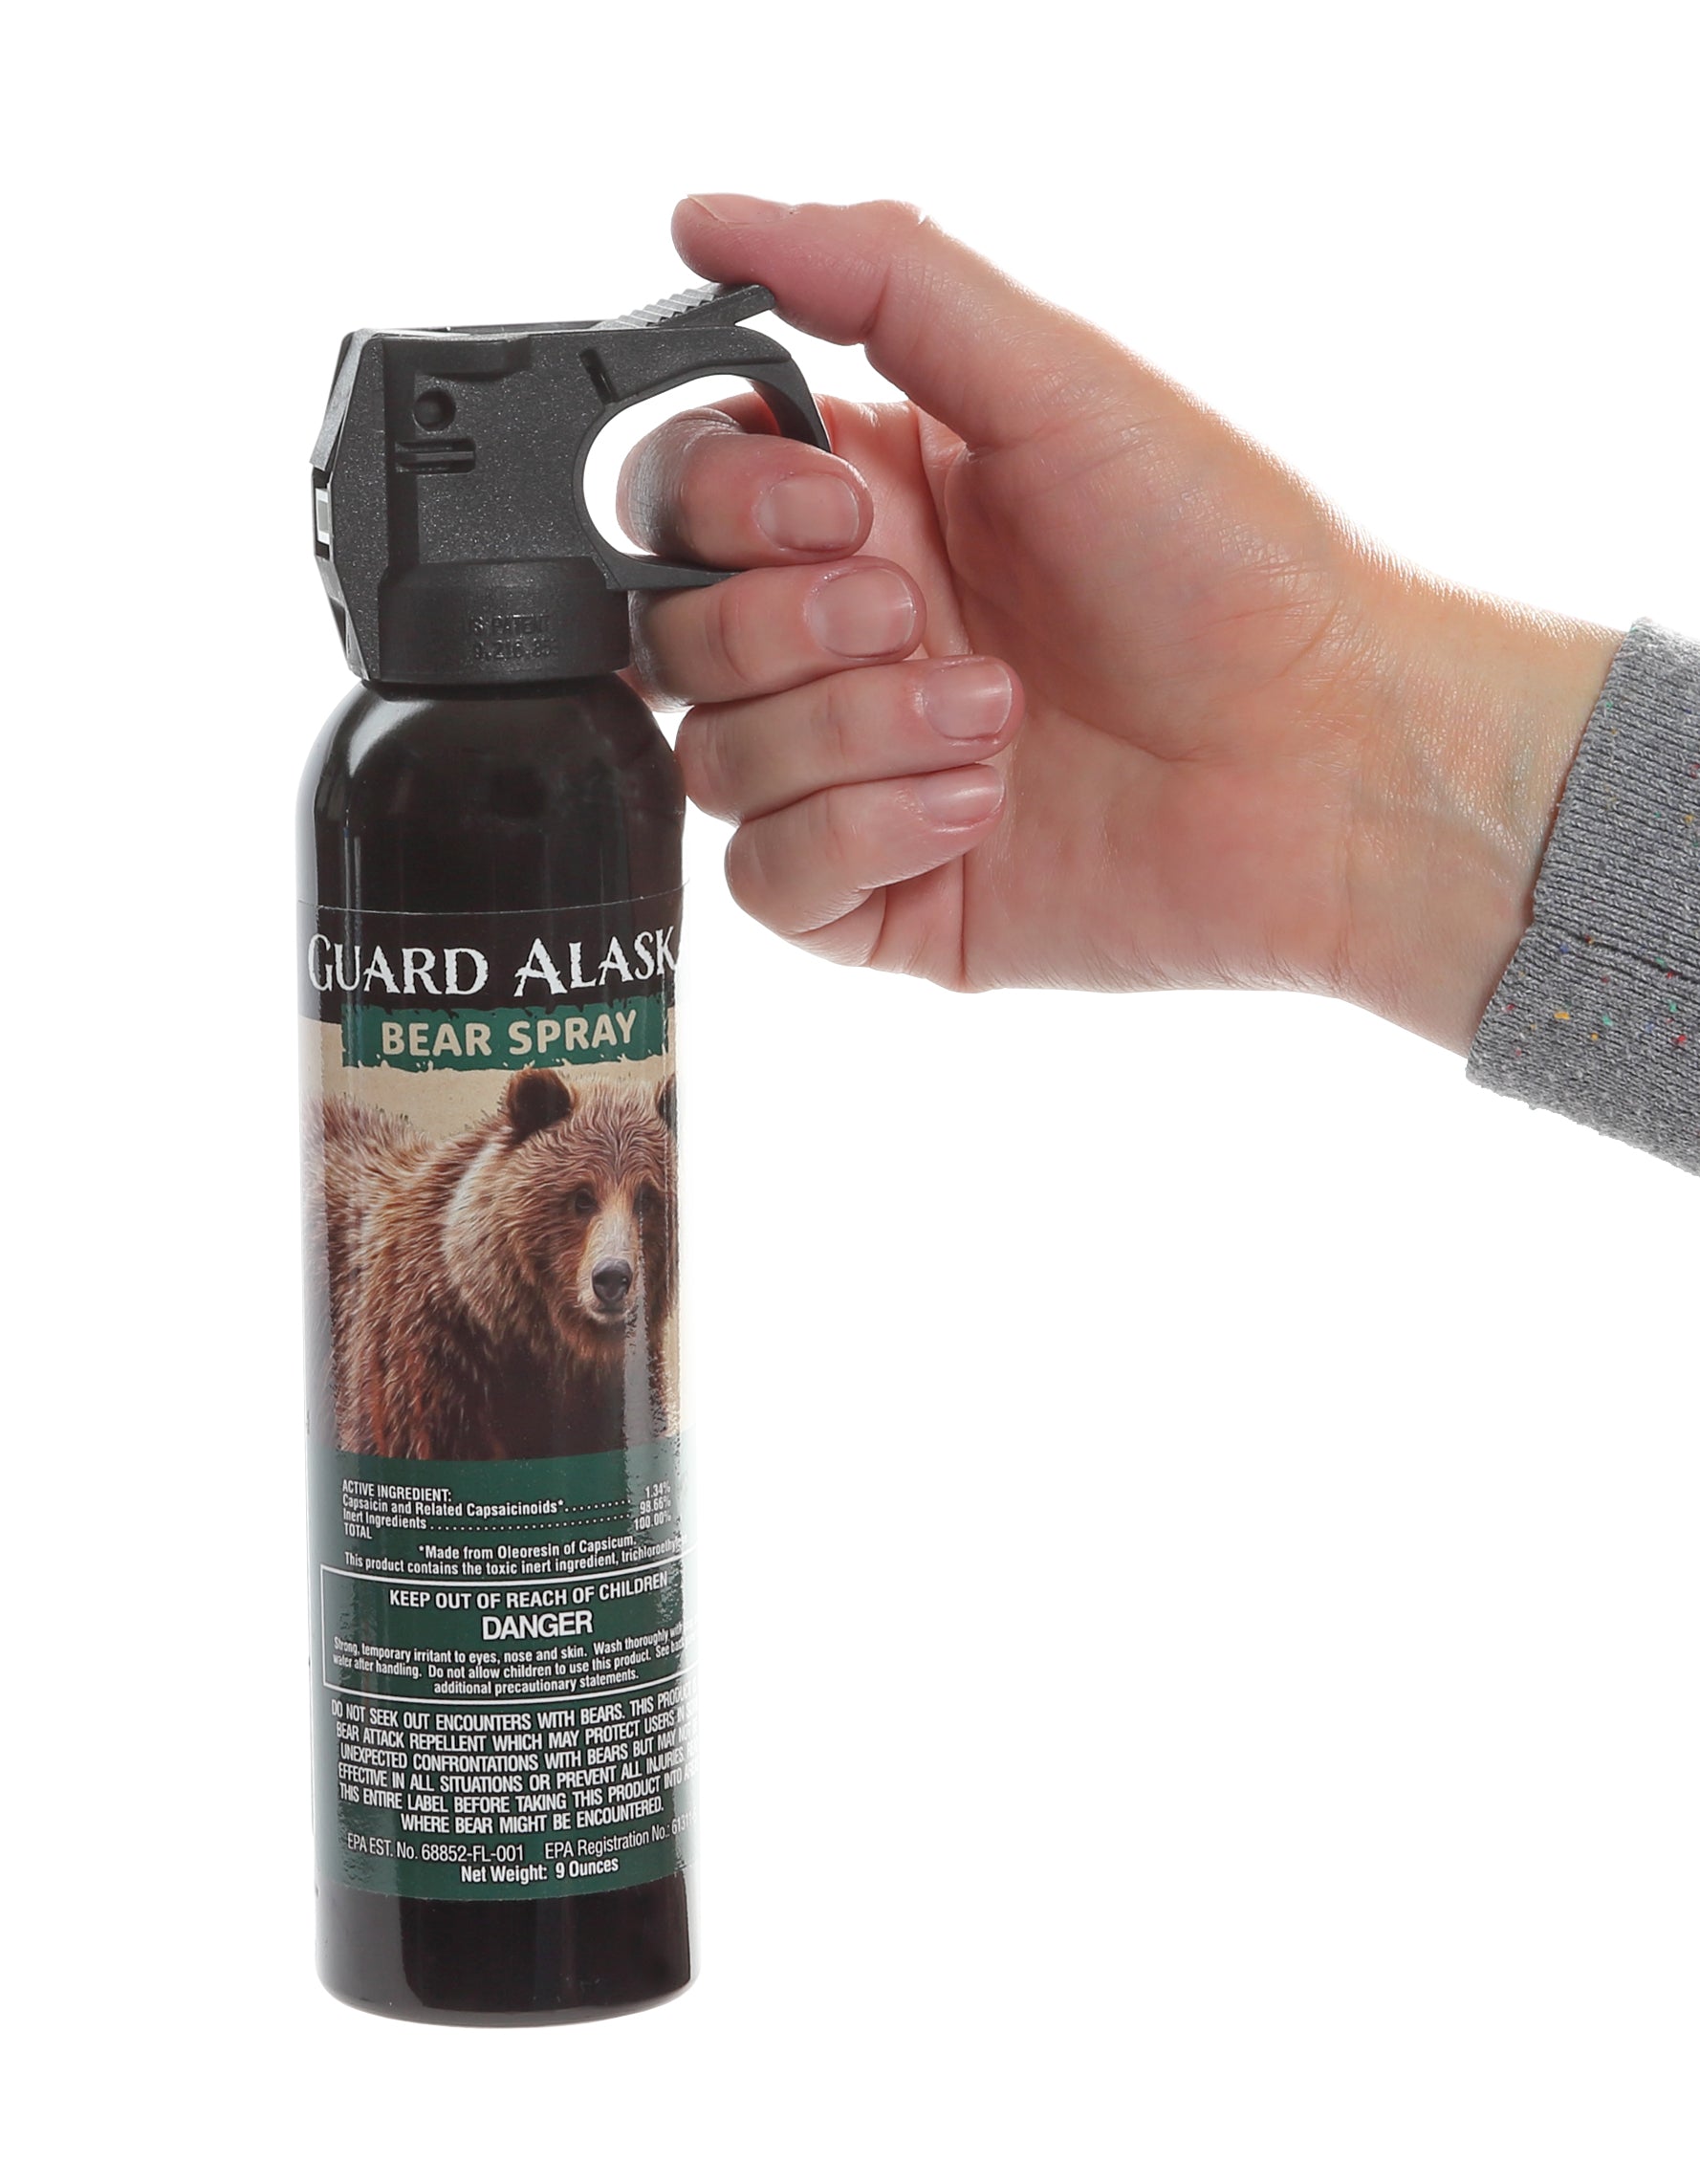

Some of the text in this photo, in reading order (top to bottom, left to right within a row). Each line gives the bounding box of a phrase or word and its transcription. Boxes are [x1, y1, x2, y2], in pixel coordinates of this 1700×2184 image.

[513, 926, 680, 997] ALASK
[382, 1009, 637, 1057] BEAR SPRAY
[342, 1479, 451, 1502] ACTIVE INGREDIENT:
[342, 1494, 388, 1513] Capsaicin
[391, 1502, 411, 1514] and
[415, 1502, 462, 1516] Related
[645, 1481, 670, 1498] 1.34%
[343, 1508, 363, 1522] Inert
[365, 1512, 427, 1529] Ingredients
[343, 1512, 671, 1539] TOTAL 100.00%
[344, 1551, 362, 1567] This
[365, 1558, 403, 1572] product
[407, 1562, 458, 1575] contains
[462, 1562, 482, 1575] the
[486, 1561, 518, 1576] toxic
[522, 1561, 552, 1574] inert
[556, 1554, 619, 1572] ingredient,
[464, 1546, 493, 1559] from
[497, 1543, 560, 1559] Oleoresin
[564, 1541, 576, 1555] of
[578, 1536, 636, 1555] Capsicum.
[390, 1571, 668, 1608] KEEP OUT OF REACH OF CHILDREN
[482, 1610, 593, 1640] DANGER
[332, 1654, 352, 1668] water
[354, 1658, 374, 1671] after
[376, 1660, 422, 1679] handling.
[428, 1665, 444, 1678] Do
[447, 1667, 466, 1678] not
[469, 1666, 500, 1679] allow
[503, 1664, 553, 1677] children
[556, 1663, 566, 1675] to
[570, 1662, 589, 1673] use
[592, 1656, 611, 1671] this
[614, 1650, 651, 1670] product.
[656, 1645, 669, 1658] See
[334, 1636, 360, 1655] Strong,
[362, 1643, 411, 1663] temporary
[414, 1649, 454, 1663] irritant
[454, 1650, 466, 1662] to
[469, 1652, 500, 1665] eyes,
[504, 1649, 533, 1662] nose
[536, 1648, 557, 1660] and
[561, 1645, 587, 1659] skin.
[594, 1641, 622, 1655] Wash
[624, 1629, 668, 1650] thoroughly
[434, 1669, 639, 1696] additional precautionary statements.
[331, 1699, 343, 1717] DO
[346, 1703, 365, 1722] NOT
[370, 1708, 399, 1728] SEEK
[403, 1712, 430, 1730] OUT
[435, 1713, 532, 1731] ENCOUNTERS
[537, 1710, 575, 1729] WITH
[580, 1704, 625, 1725] BEARS.
[630, 1697, 654, 1717] THIS
[337, 1721, 360, 1742] BEAR
[363, 1728, 404, 1749] ATTACK
[409, 1733, 487, 1752] REPELLENT
[492, 1734, 542, 1752] WHICH
[549, 1730, 579, 1749] MAY
[585, 1720, 641, 1745] PROTECT
[644, 1710, 675, 1735] USERS
[340, 1742, 407, 1769] UNEXPECTED
[413, 1754, 539, 1773] CONFRONTATIONS
[544, 1750, 581, 1770] WITH
[587, 1743, 628, 1765] BEARS
[633, 1736, 655, 1757] BUT
[658, 1729, 677, 1750] MAY
[338, 1761, 387, 1787] EFFECTIVE
[392, 1771, 405, 1789] IN
[410, 1774, 434, 1791] ALL
[440, 1775, 523, 1793] SITUATIONS
[529, 1774, 551, 1791] OR
[557, 1764, 617, 1789] PREVENT
[621, 1760, 643, 1780] ALL
[339, 1782, 360, 1802] THIS
[363, 1788, 403, 1809] ENTIRE
[407, 1793, 448, 1812] LABEL
[454, 1796, 510, 1813] BEFORE
[515, 1792, 566, 1812] TAKING
[573, 1789, 602, 1808] THIS
[608, 1775, 661, 1803] PRODUCT
[665, 1770, 681, 1790] INTO
[401, 1796, 664, 1834] WHERE BEAR MIGHT BE ENCOUNTERED.
[347, 1832, 367, 1852] EPA
[369, 1837, 393, 1857] EST.
[397, 1842, 418, 1860] No.
[421, 1844, 524, 1863] 68852-FL-001
[545, 1842, 574, 1859] EPA
[578, 1830, 650, 1858] Registration
[461, 1858, 619, 1886] Net Weight: 9 Ounces
